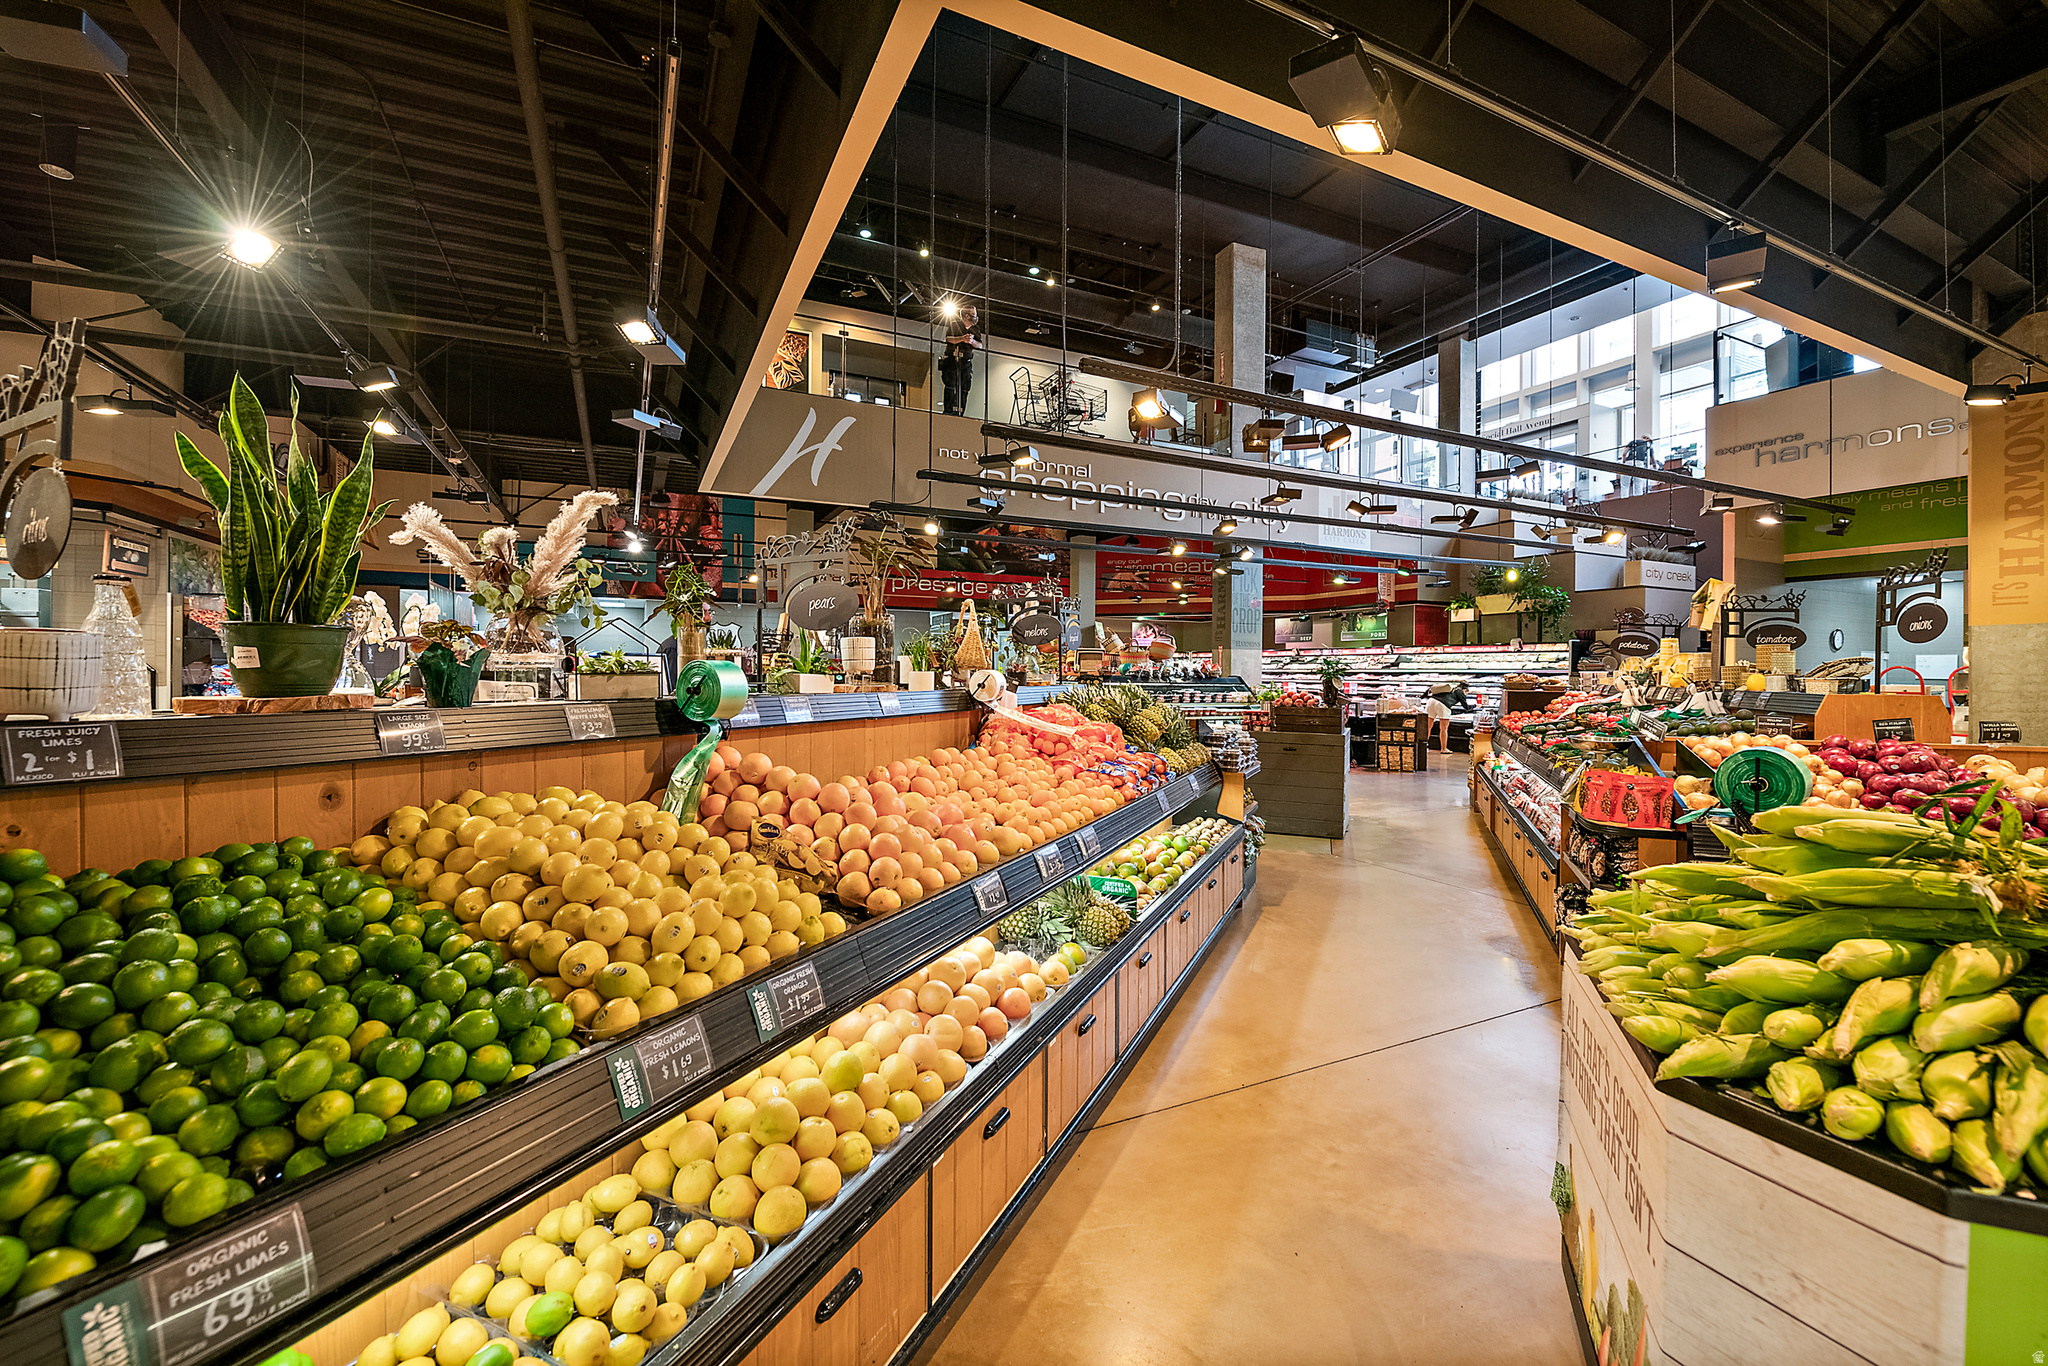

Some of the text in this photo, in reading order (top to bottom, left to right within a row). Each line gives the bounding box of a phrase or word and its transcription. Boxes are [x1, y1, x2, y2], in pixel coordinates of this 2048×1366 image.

[1506, 424, 1522, 435] Hall
[1524, 418, 1555, 429] Avenue
[750, 407, 857, 497] H
[1714, 432, 1805, 457] experience
[1755, 416, 1956, 468] harmons
[938, 447, 969, 460] not
[1868, 480, 1950, 499] means
[979, 468, 1187, 522] shopping
[1229, 497, 1296, 534] city
[1880, 495, 1969, 511] and fres
[1991, 397, 2046, 606] IT'S HARMONS
[1322, 524, 1367, 539] HARMONS
[1324, 535, 1365, 545] CITY CREEK
[1152, 559, 1213, 573] meat
[1645, 566, 1693, 582] city creek
[1232, 567, 1259, 594] PICK
[808, 596, 836, 617] pears
[1240, 593, 1251, 608] THE
[1024, 623, 1049, 638] melons
[1232, 607, 1261, 634] CROP
[1908, 615, 1934, 632] onions
[1617, 641, 1650, 651] potatoes
[1755, 633, 1798, 645] tomatoes
[387, 714, 413, 722] LARGE
[18, 726, 101, 739] FRESH JUICY
[41, 738, 83, 748] LIMES
[21, 752, 44, 773] 2
[44, 754, 61, 763] for
[15, 773, 54, 783] MEXICO
[1101, 885, 1129, 894] ORGANIC
[772, 967, 814, 990] ORGANIC FRESH
[783, 979, 809, 996] ORANGES
[757, 991, 774, 1032] ORGANIC
[652, 1027, 687, 1050] ORGANIC
[644, 1032, 701, 1069] FRESH LEMONS
[616, 1071, 632, 1109] CERTIFIED
[621, 1059, 641, 1109] ORGANIC
[1567, 992, 1642, 1171] ALL THAT'S GOOD.
[1565, 1031, 1597, 1127] NOTHING
[1599, 1100, 1621, 1182] THAT
[185, 1229, 269, 1278] ORGANIC
[168, 1240, 291, 1309] FRESH LIMES
